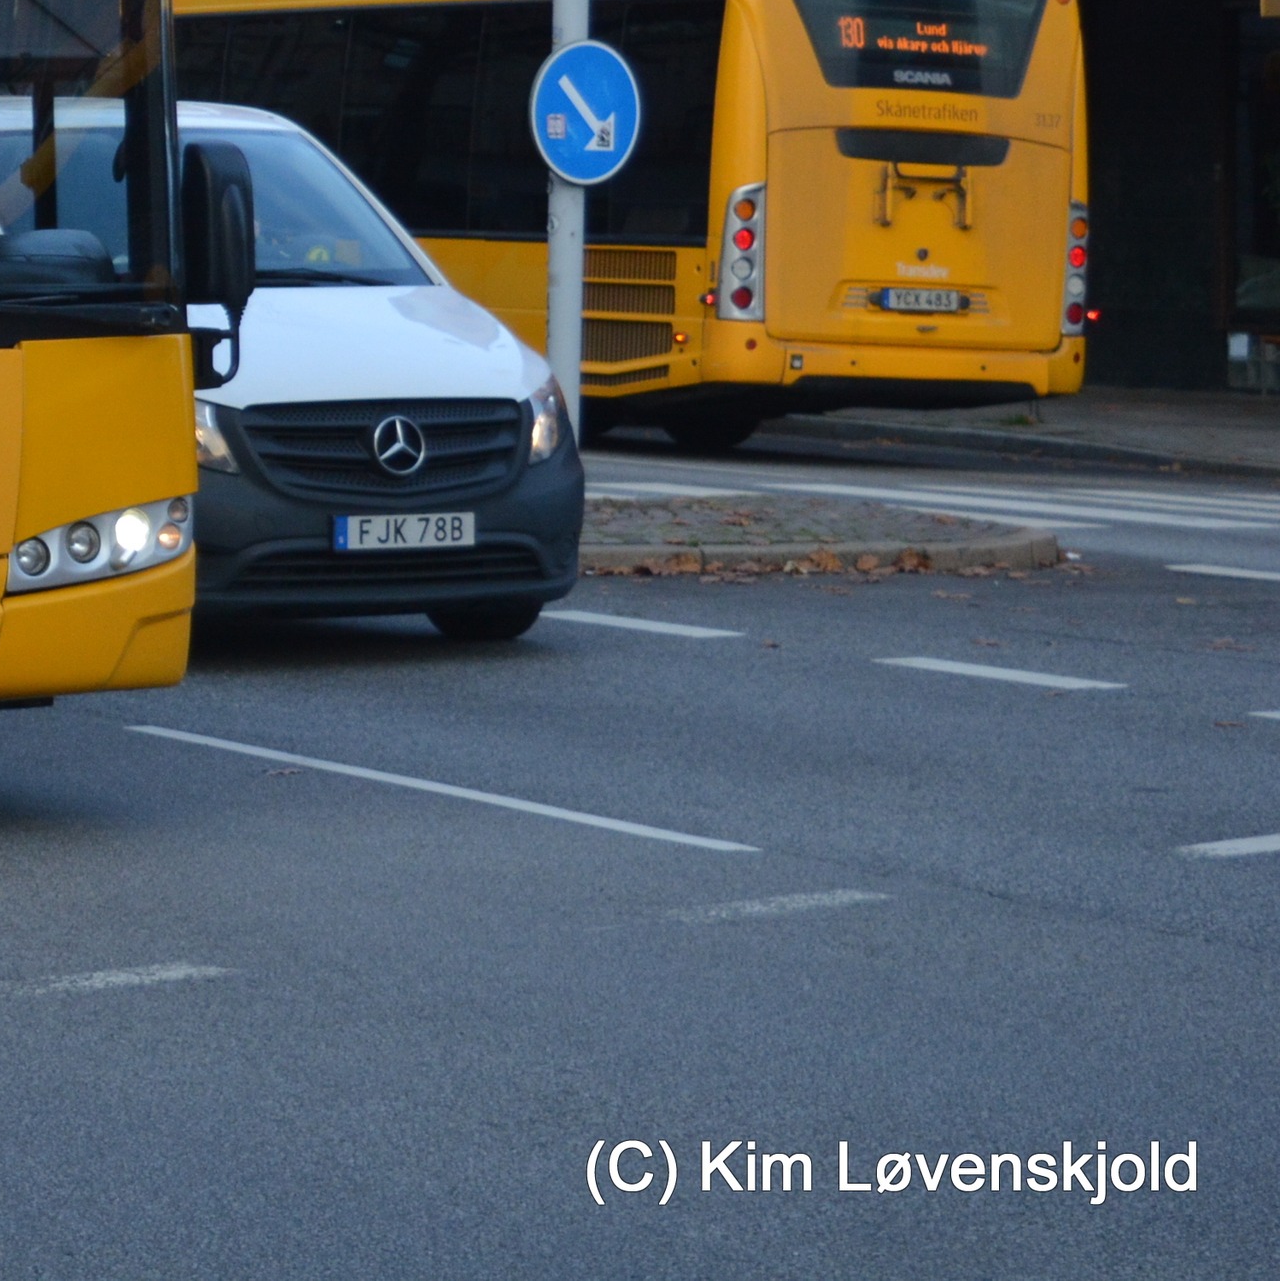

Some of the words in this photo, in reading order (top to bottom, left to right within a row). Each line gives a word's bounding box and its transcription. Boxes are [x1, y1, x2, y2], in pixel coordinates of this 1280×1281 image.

[838, 17, 865, 49] 130
[916, 21, 947, 37] Lund
[893, 70, 953, 86] SCANIA
[876, 98, 978, 123] Skånetrafiken
[359, 518, 406, 545] FJK
[417, 516, 463, 543] 78B
